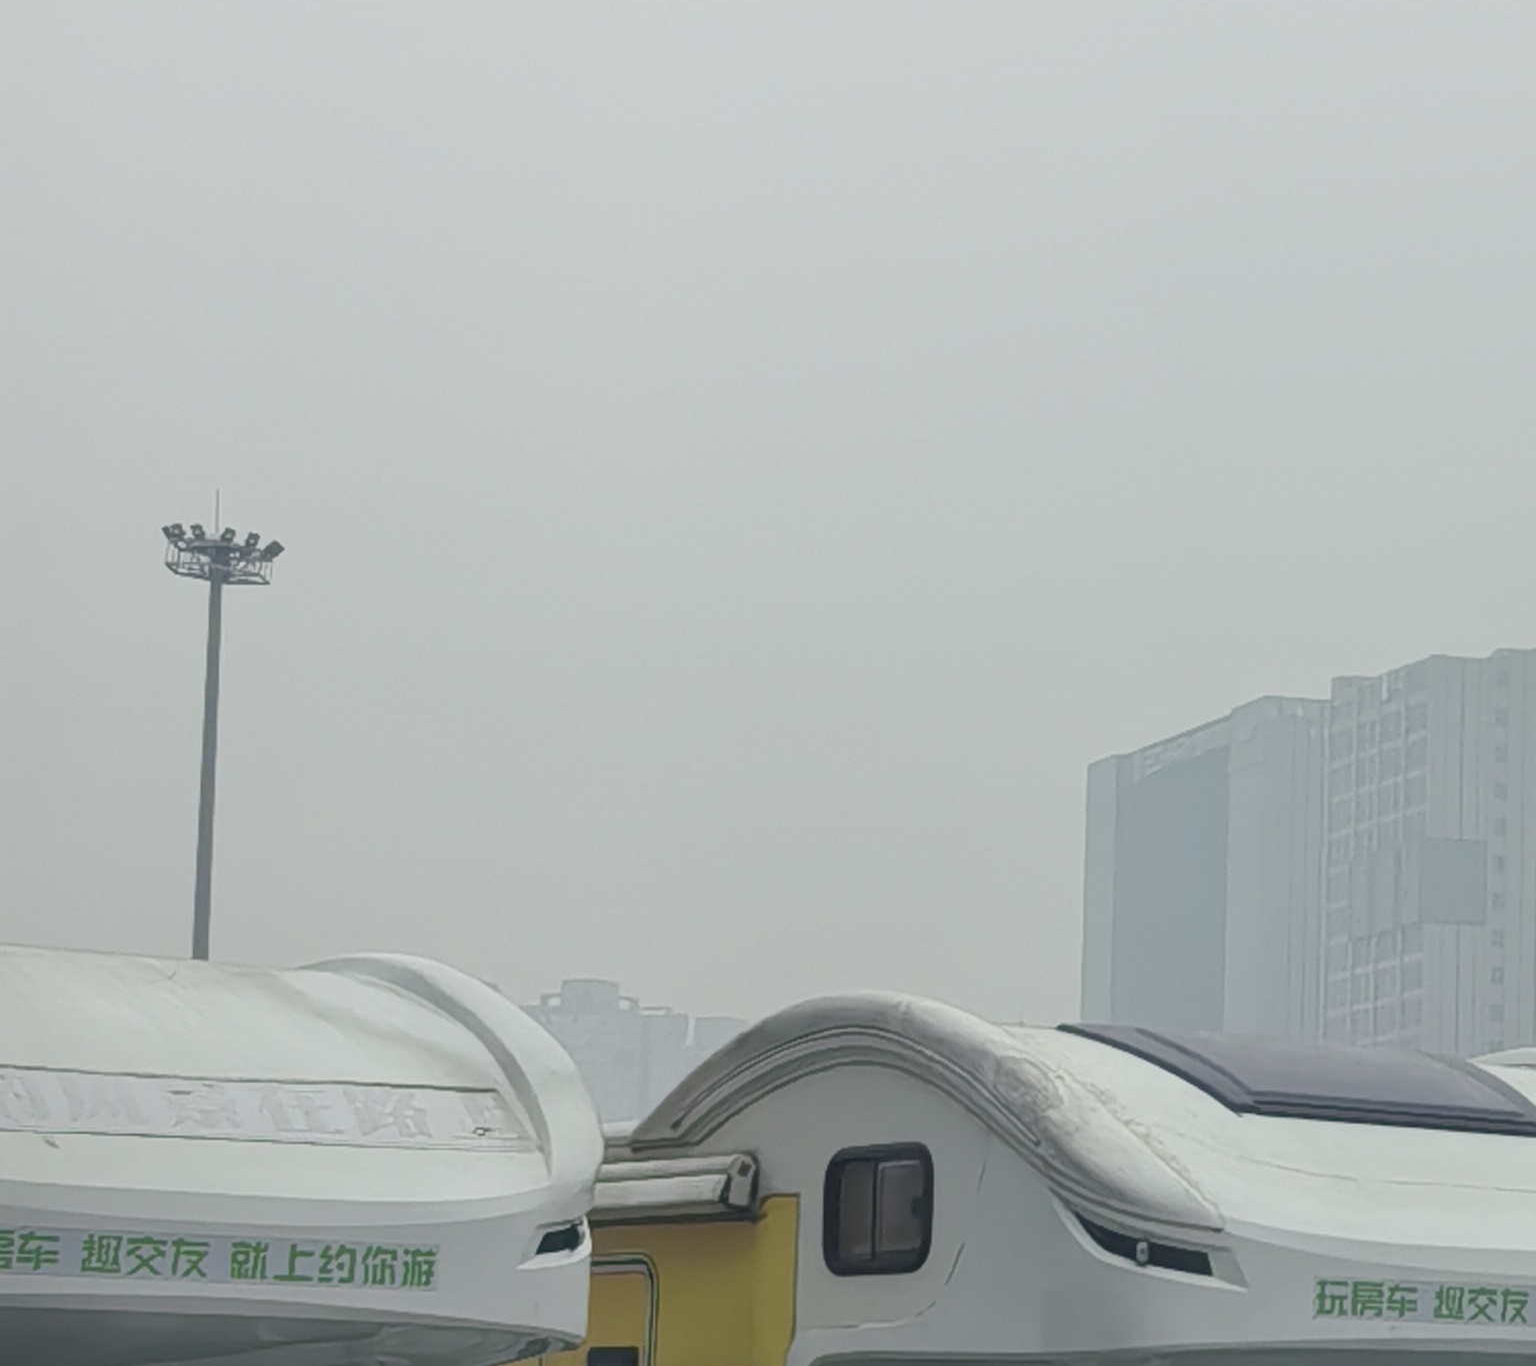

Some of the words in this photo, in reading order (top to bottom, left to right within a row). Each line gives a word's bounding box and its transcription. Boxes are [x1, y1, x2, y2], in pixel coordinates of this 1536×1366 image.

[81, 1235, 209, 1279] 趣交友
[230, 1241, 440, 1288] 就上约你游
[1315, 1280, 1418, 1319] 玩房车
